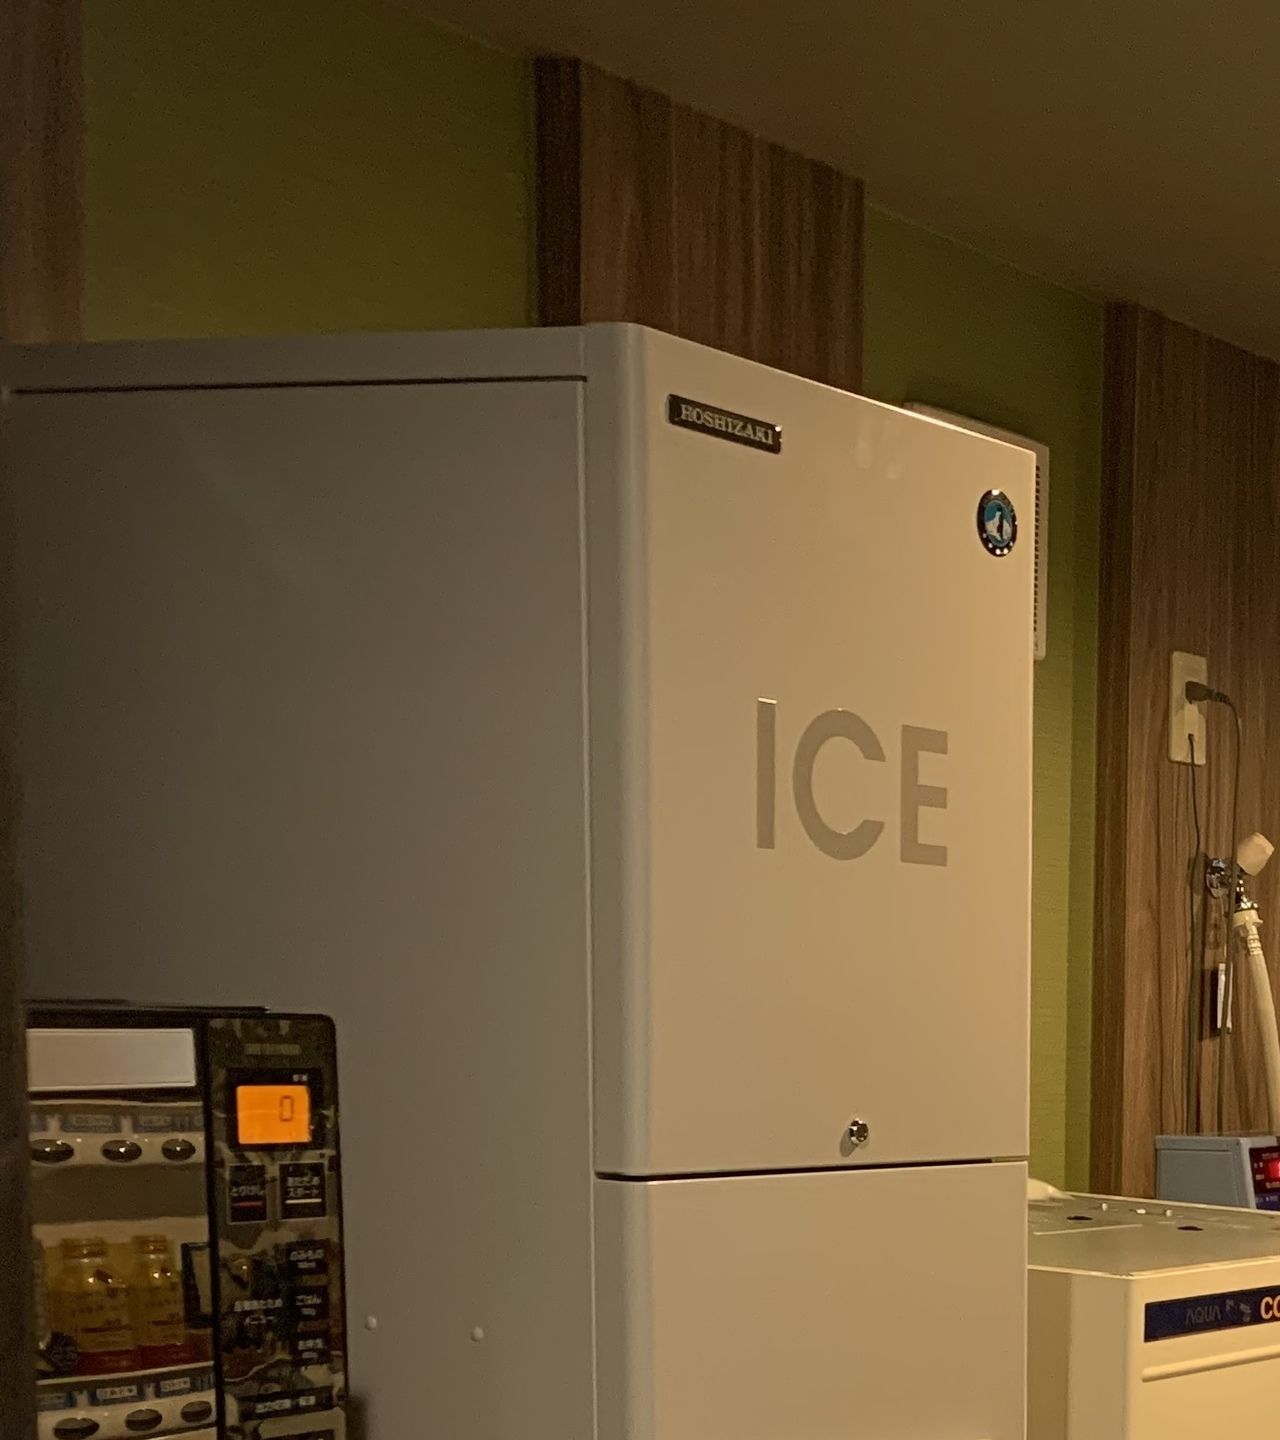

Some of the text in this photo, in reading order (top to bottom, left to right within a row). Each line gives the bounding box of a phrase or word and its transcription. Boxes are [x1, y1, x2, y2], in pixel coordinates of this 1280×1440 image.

[680, 403, 774, 445] HOSHIZAKI
[756, 697, 949, 867] ICE
[279, 1095, 294, 1122] 0
[1185, 1304, 1221, 1326] AQUA
